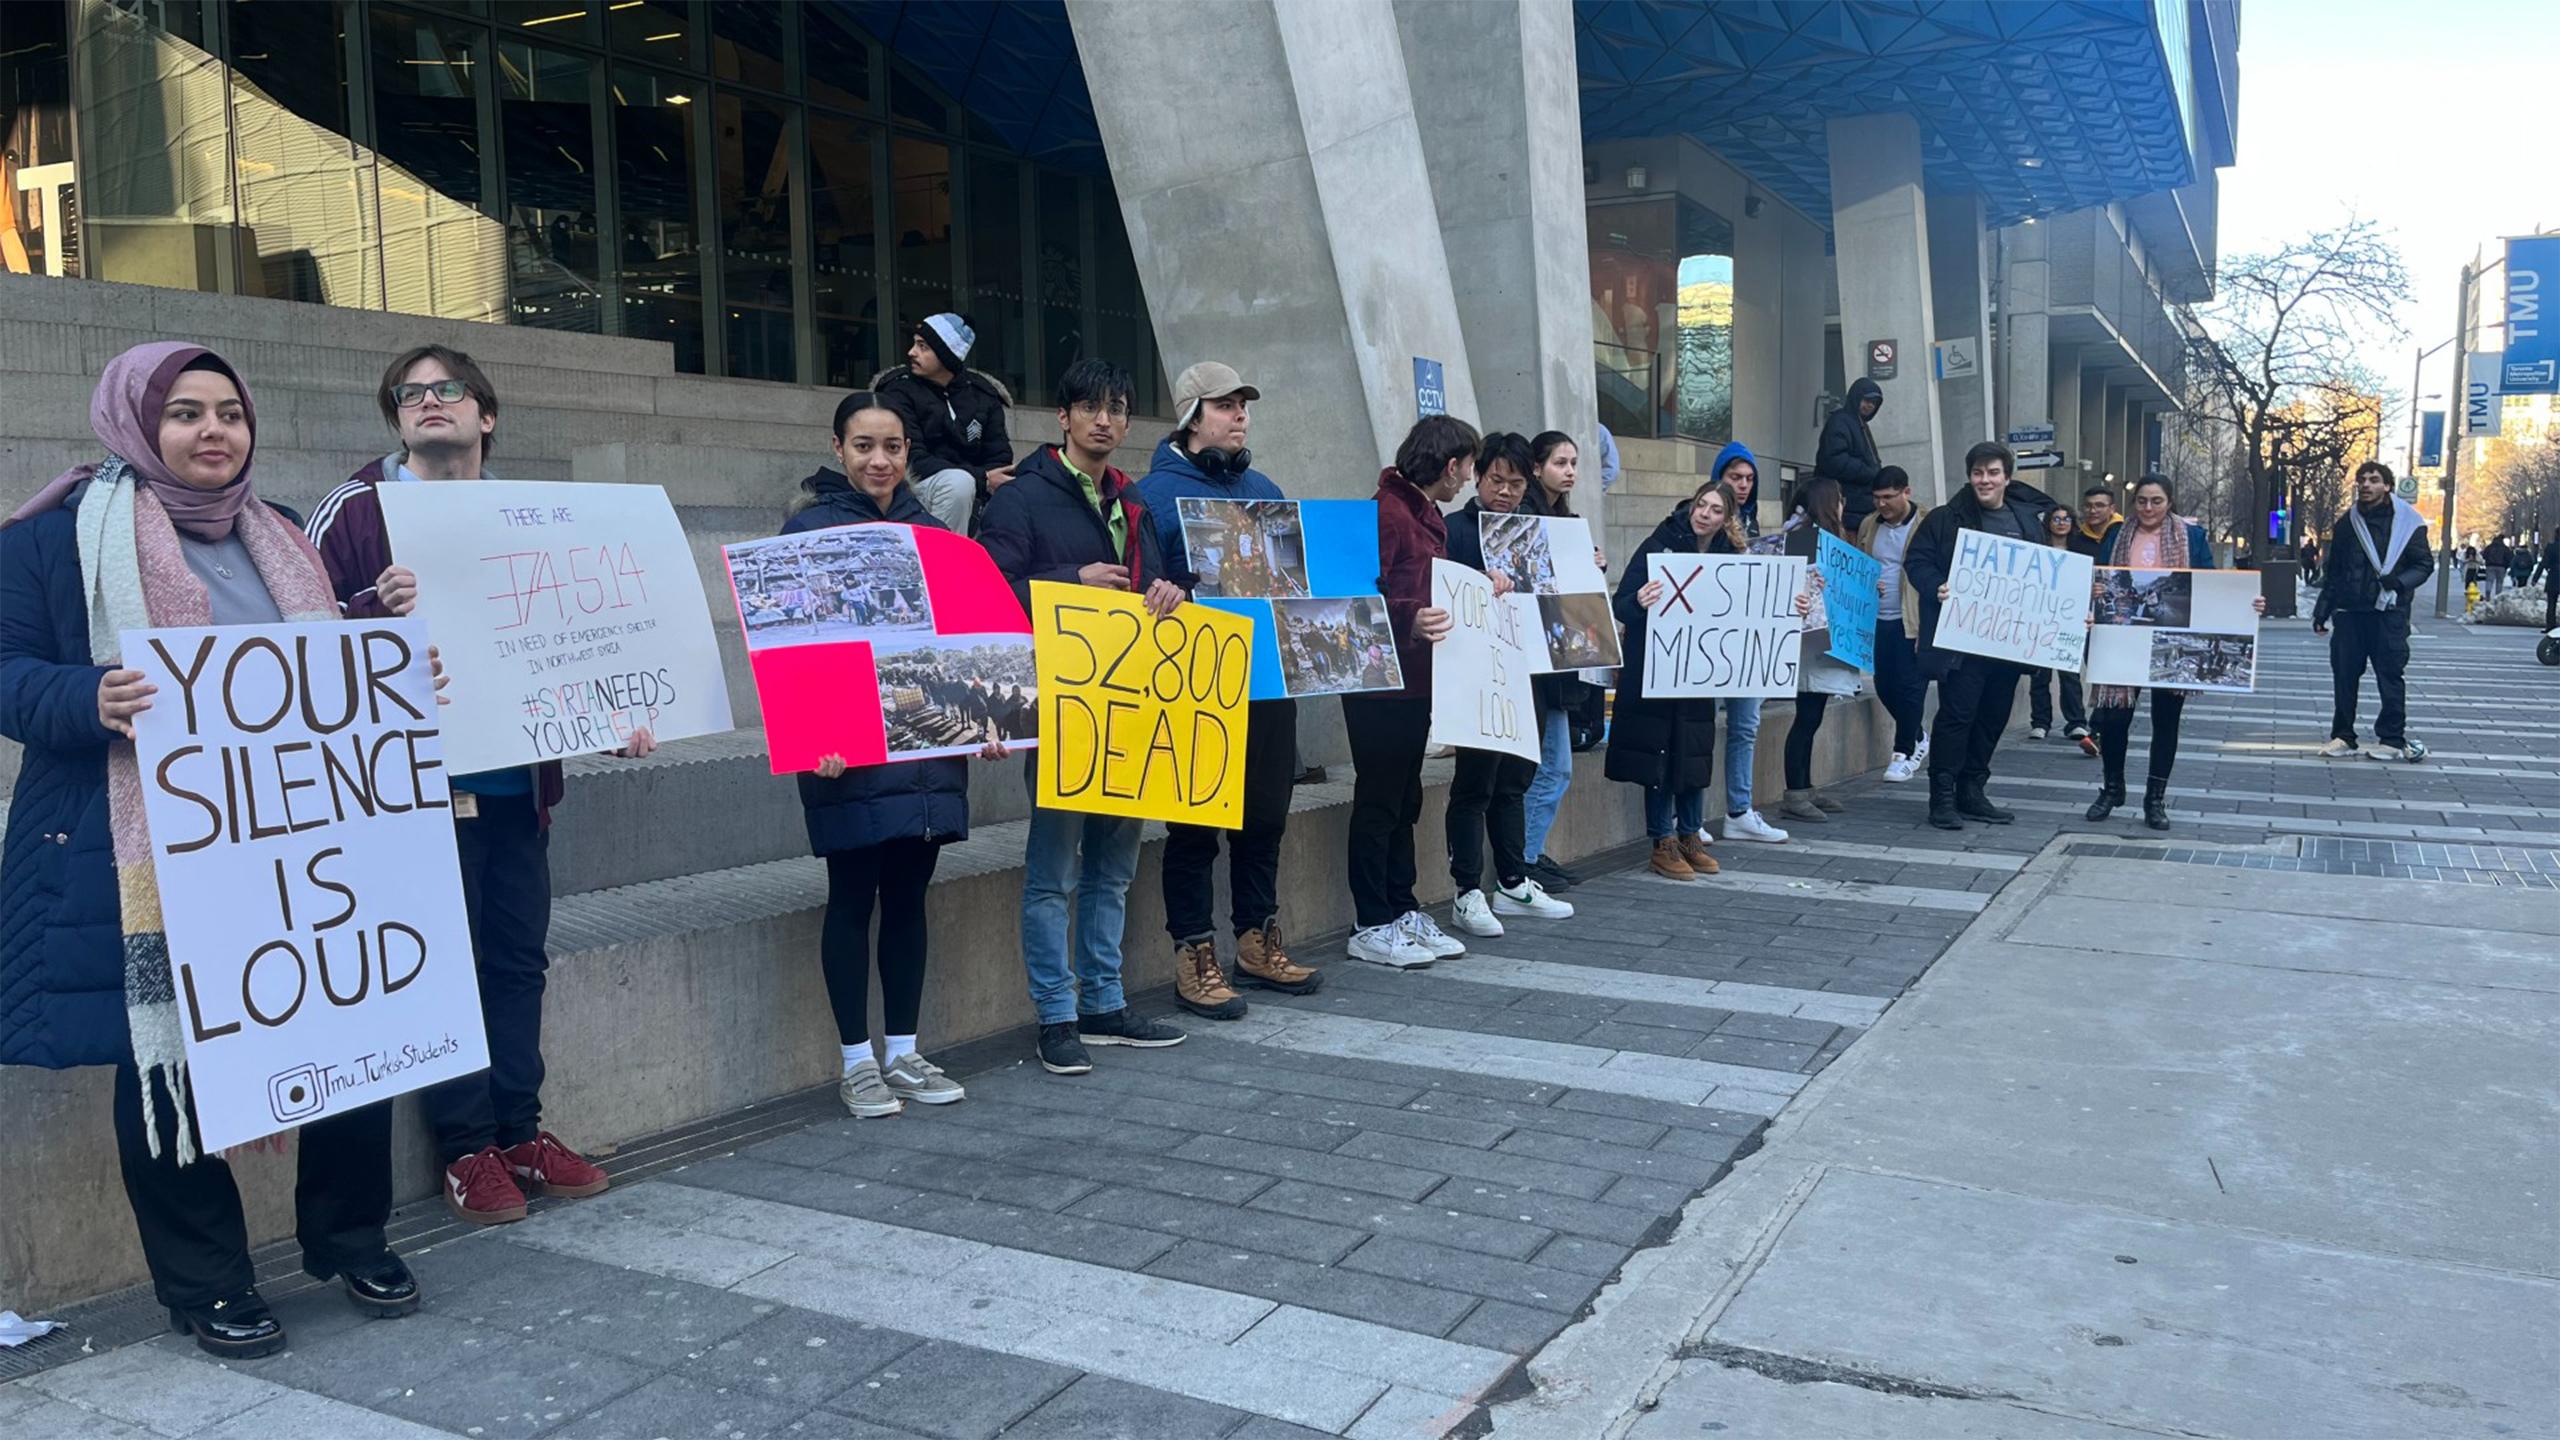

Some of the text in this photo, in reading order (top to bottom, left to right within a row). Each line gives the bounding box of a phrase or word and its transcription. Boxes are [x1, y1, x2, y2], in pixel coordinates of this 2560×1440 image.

[2508, 269, 2540, 345] TMU
[1418, 388, 1443, 408] CCTV
[2469, 383, 2489, 432] TMU
[499, 507, 575, 527] THERE ARE
[1711, 562, 1801, 619] STILL
[1959, 534, 2068, 590] HATAY
[1442, 574, 1491, 635] YOUR
[1944, 597, 2060, 660] Malatya
[494, 640, 516, 658] IN
[518, 634, 546, 651] NEED
[553, 632, 567, 646] OF
[571, 625, 624, 644] EMERGENCY
[527, 659, 544, 675] IN
[597, 641, 622, 657] SYRIA
[1054, 605, 1249, 709] 52,800
[1489, 644, 1507, 686] IS
[1651, 625, 1801, 688] MISSING
[149, 629, 425, 735] YOUR
[522, 668, 675, 718] #SYRIANEEDS
[1057, 694, 1230, 808] DEAD.
[157, 729, 449, 855] SILENCE
[274, 847, 356, 932] IS
[180, 921, 427, 1043] LOUD
